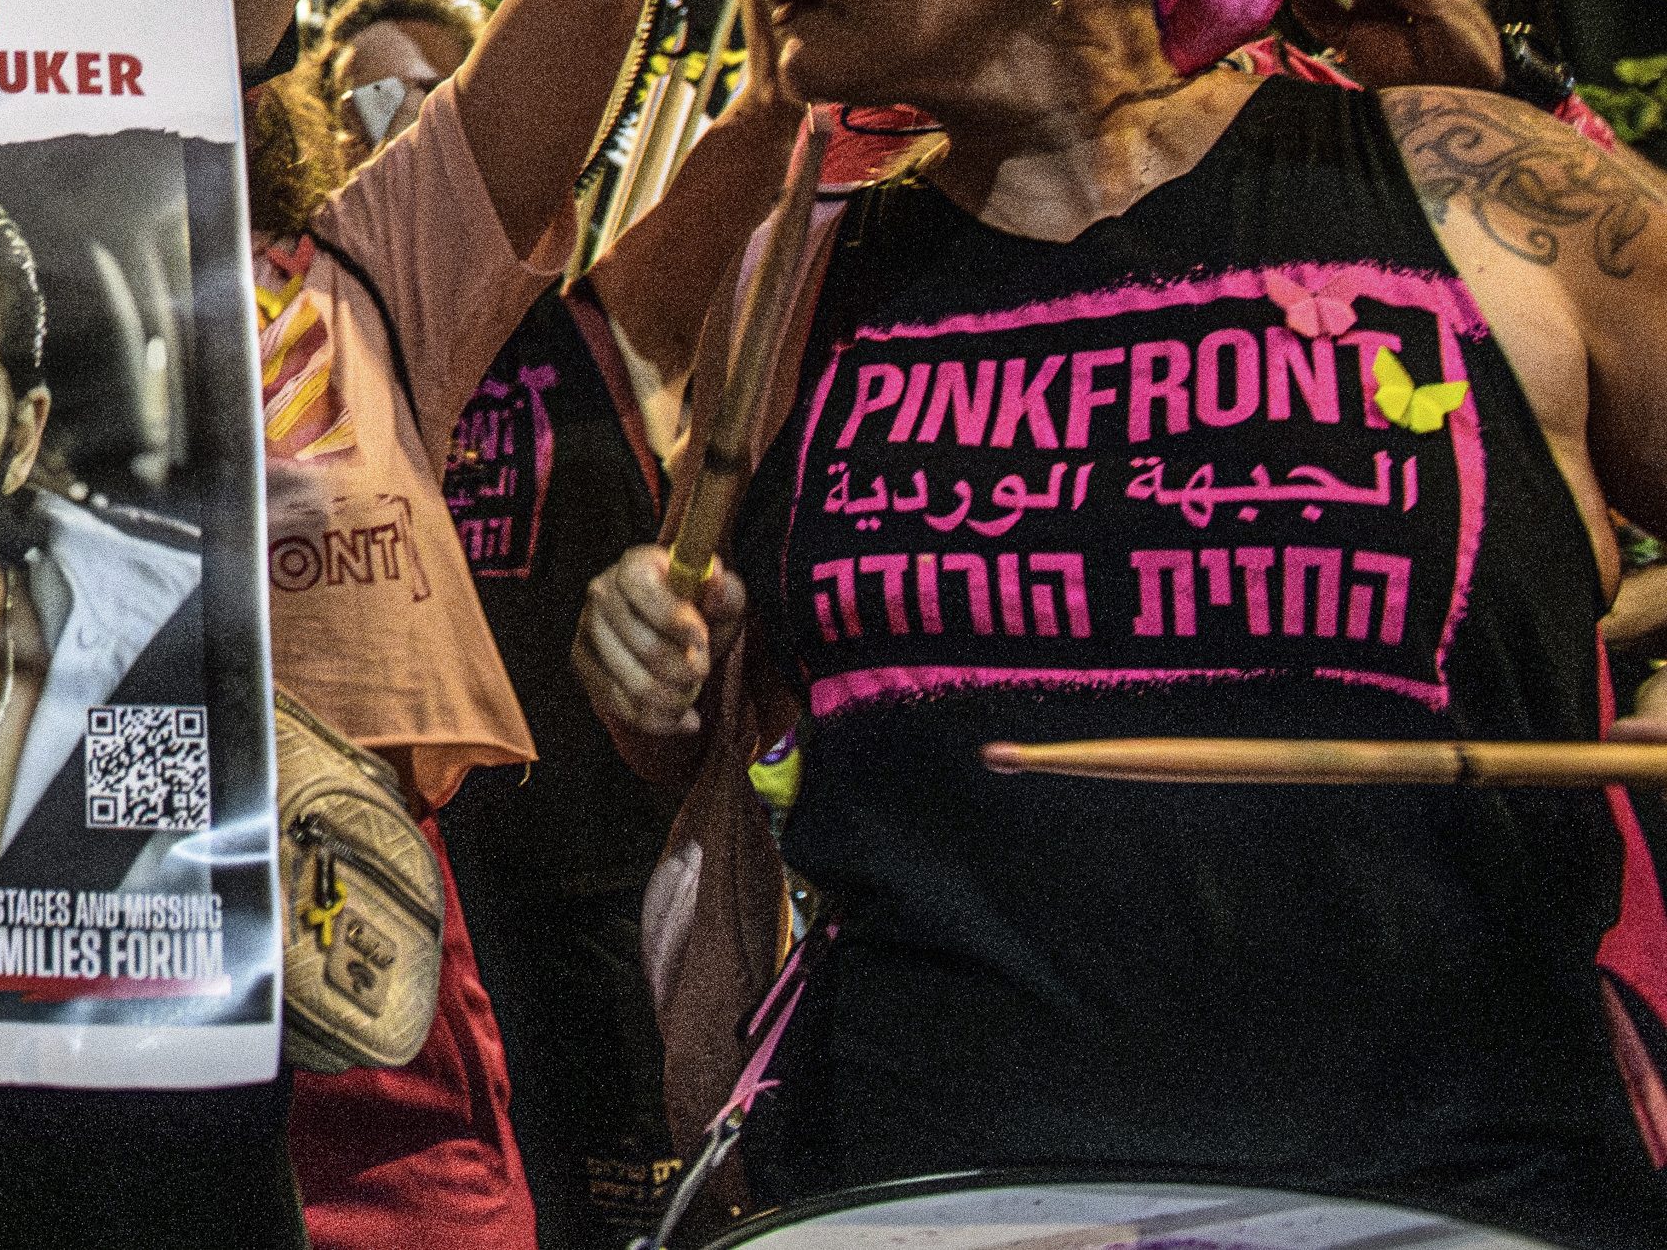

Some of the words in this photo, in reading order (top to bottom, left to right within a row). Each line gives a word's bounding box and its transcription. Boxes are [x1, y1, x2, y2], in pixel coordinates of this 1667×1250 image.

[823, 460, 1095, 537] الوردية
[1125, 451, 1419, 529] الجبهة
[810, 550, 1092, 643] הורודה
[1130, 547, 1413, 646] החזית
[75, 892, 118, 929] AND
[124, 893, 223, 932] MISSING
[109, 930, 224, 980] FORUM
